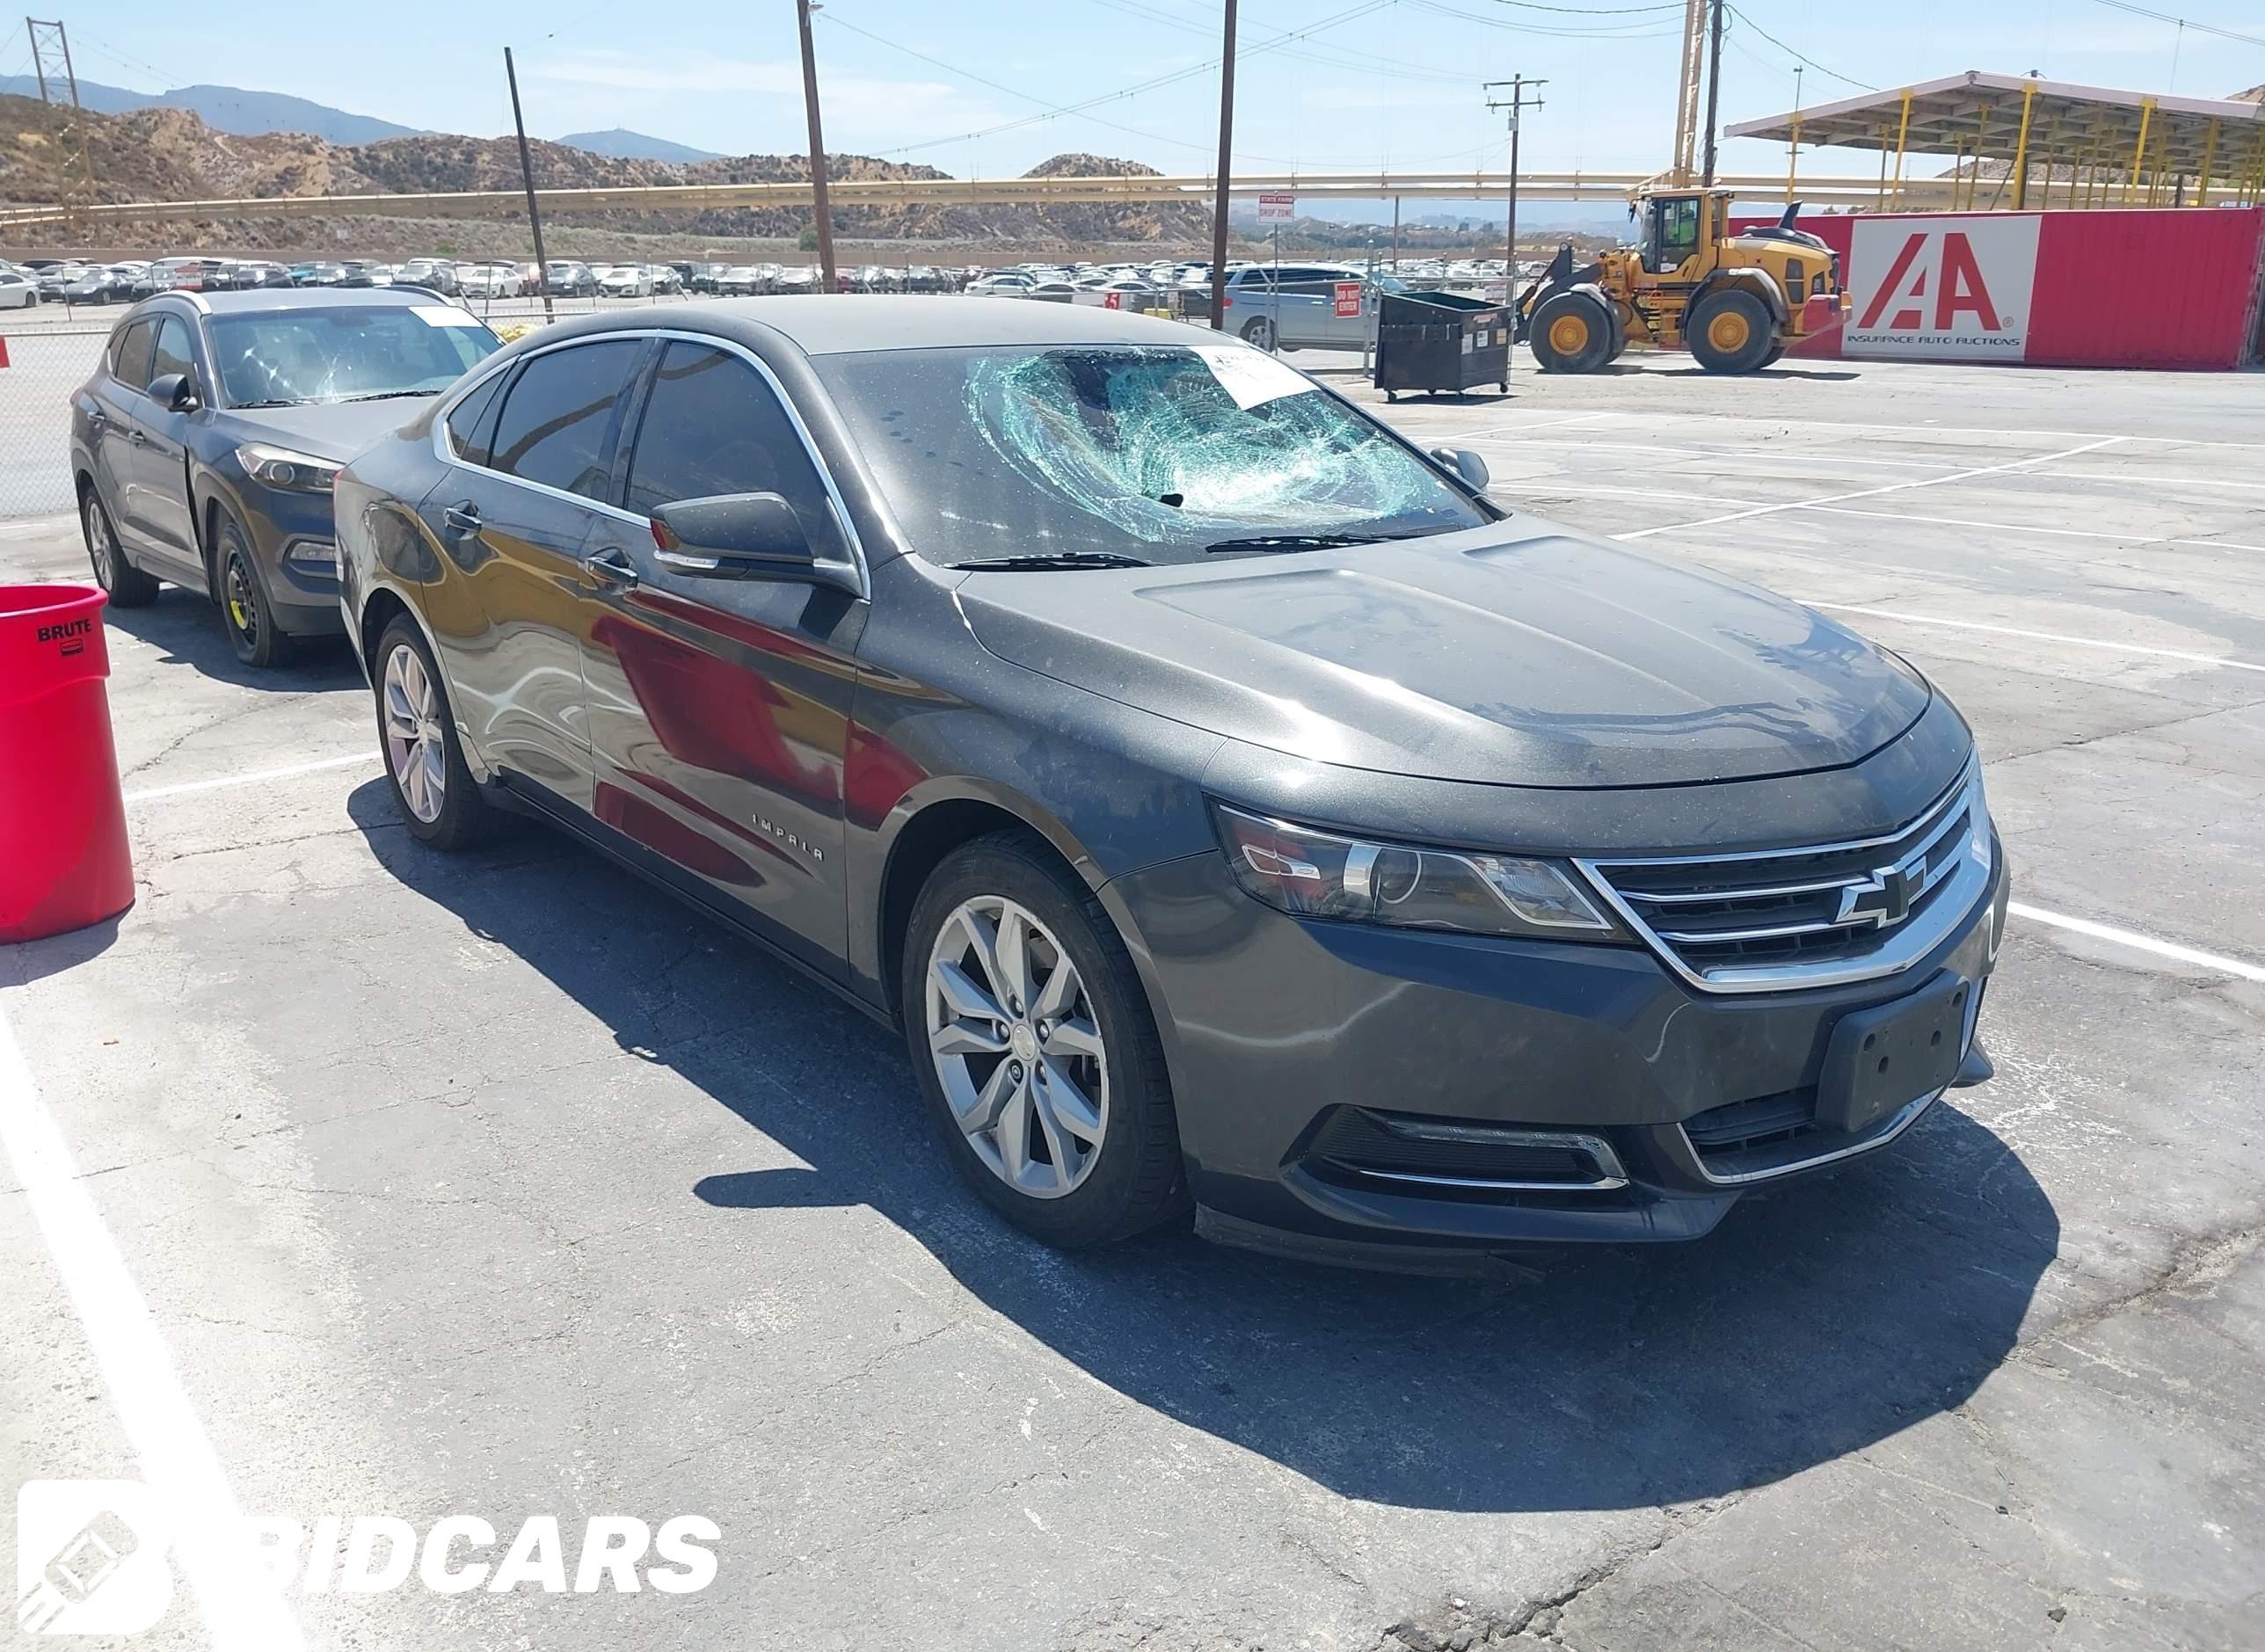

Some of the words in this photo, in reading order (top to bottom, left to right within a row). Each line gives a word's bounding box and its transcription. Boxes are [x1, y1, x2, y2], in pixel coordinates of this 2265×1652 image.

[1847, 335, 1914, 344] INSURANCE
[1919, 336, 1953, 345] AUTO
[1955, 337, 2021, 346] AUCTIONS
[37, 618, 92, 643] BRUTE
[753, 812, 825, 862] IMPALA
